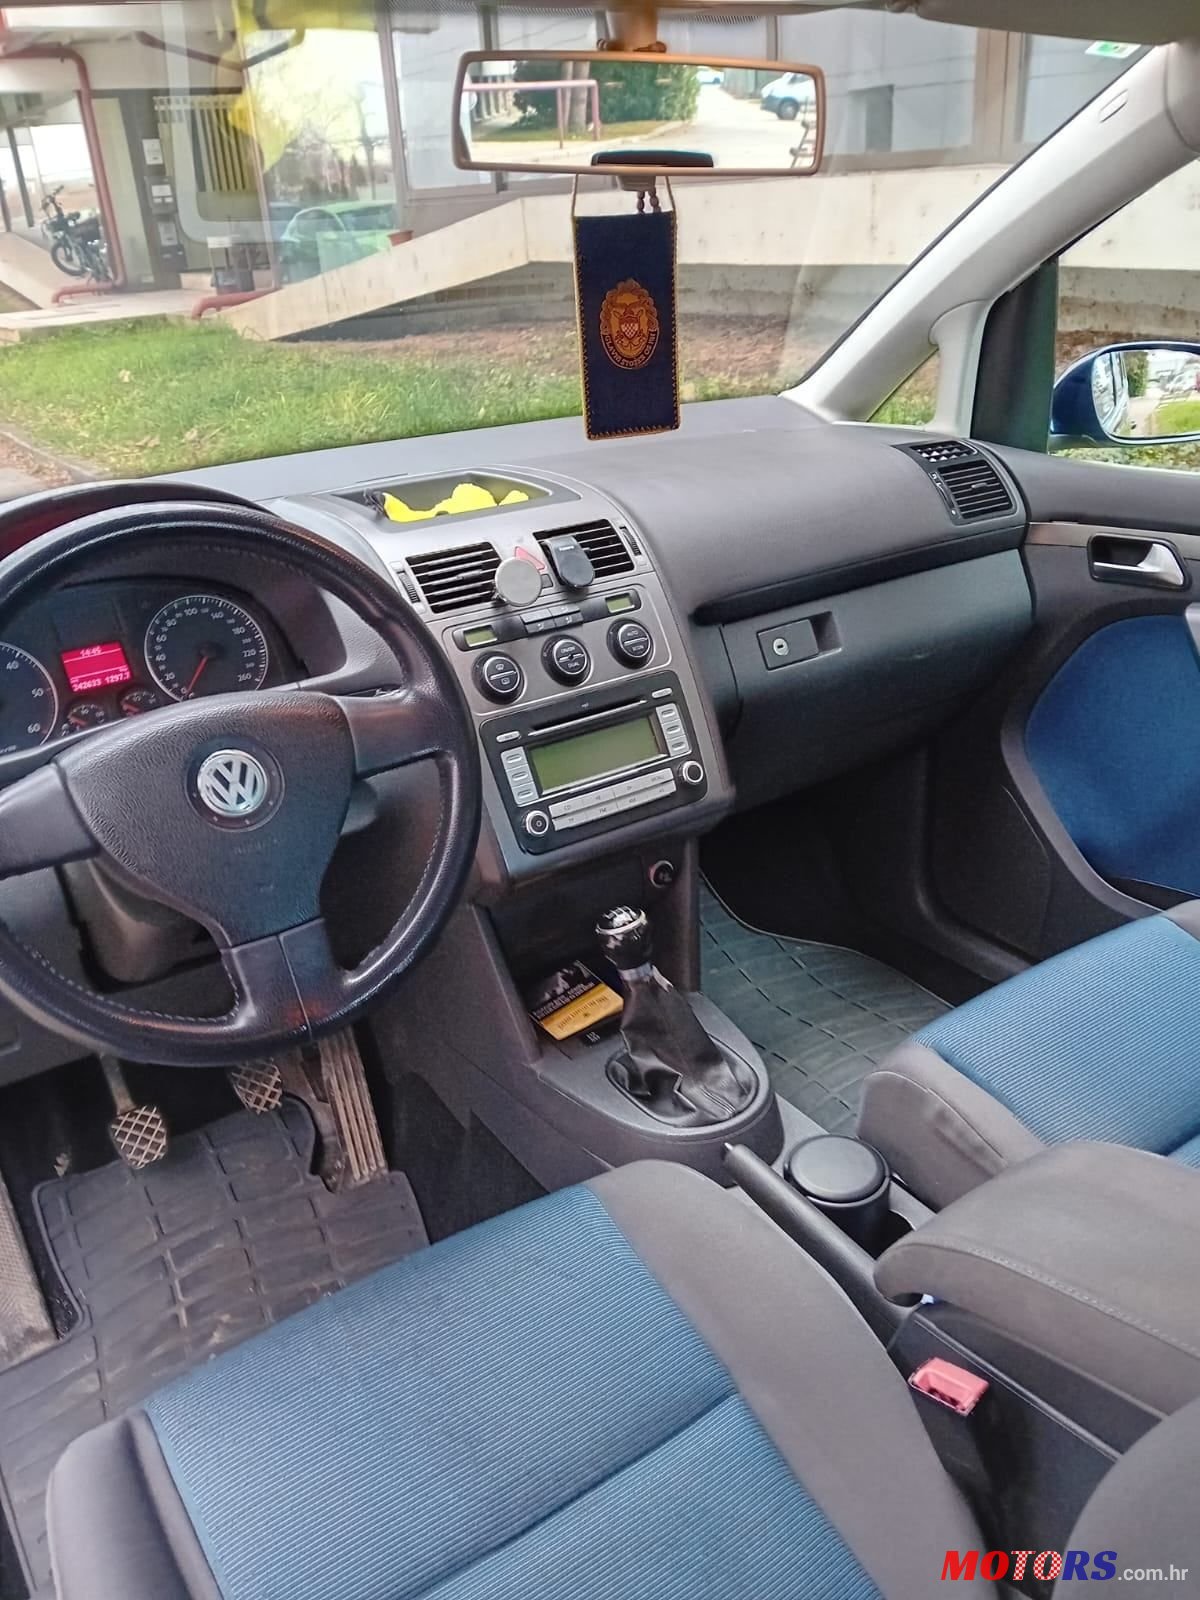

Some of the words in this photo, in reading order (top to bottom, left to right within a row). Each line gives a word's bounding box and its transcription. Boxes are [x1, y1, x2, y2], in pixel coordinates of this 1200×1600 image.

[184, 607, 198, 616] 100
[210, 611, 224, 620] 140
[165, 619, 177, 627] 80
[156, 634, 167, 643] 60
[155, 653, 166, 662] 40
[242, 648, 257, 658] 220
[6, 660, 19, 671] 40
[164, 672, 176, 681] 20
[237, 672, 252, 682] 260
[31, 687, 44, 698] 50
[27, 723, 41, 734] 60
[203, 755, 262, 812] VW
